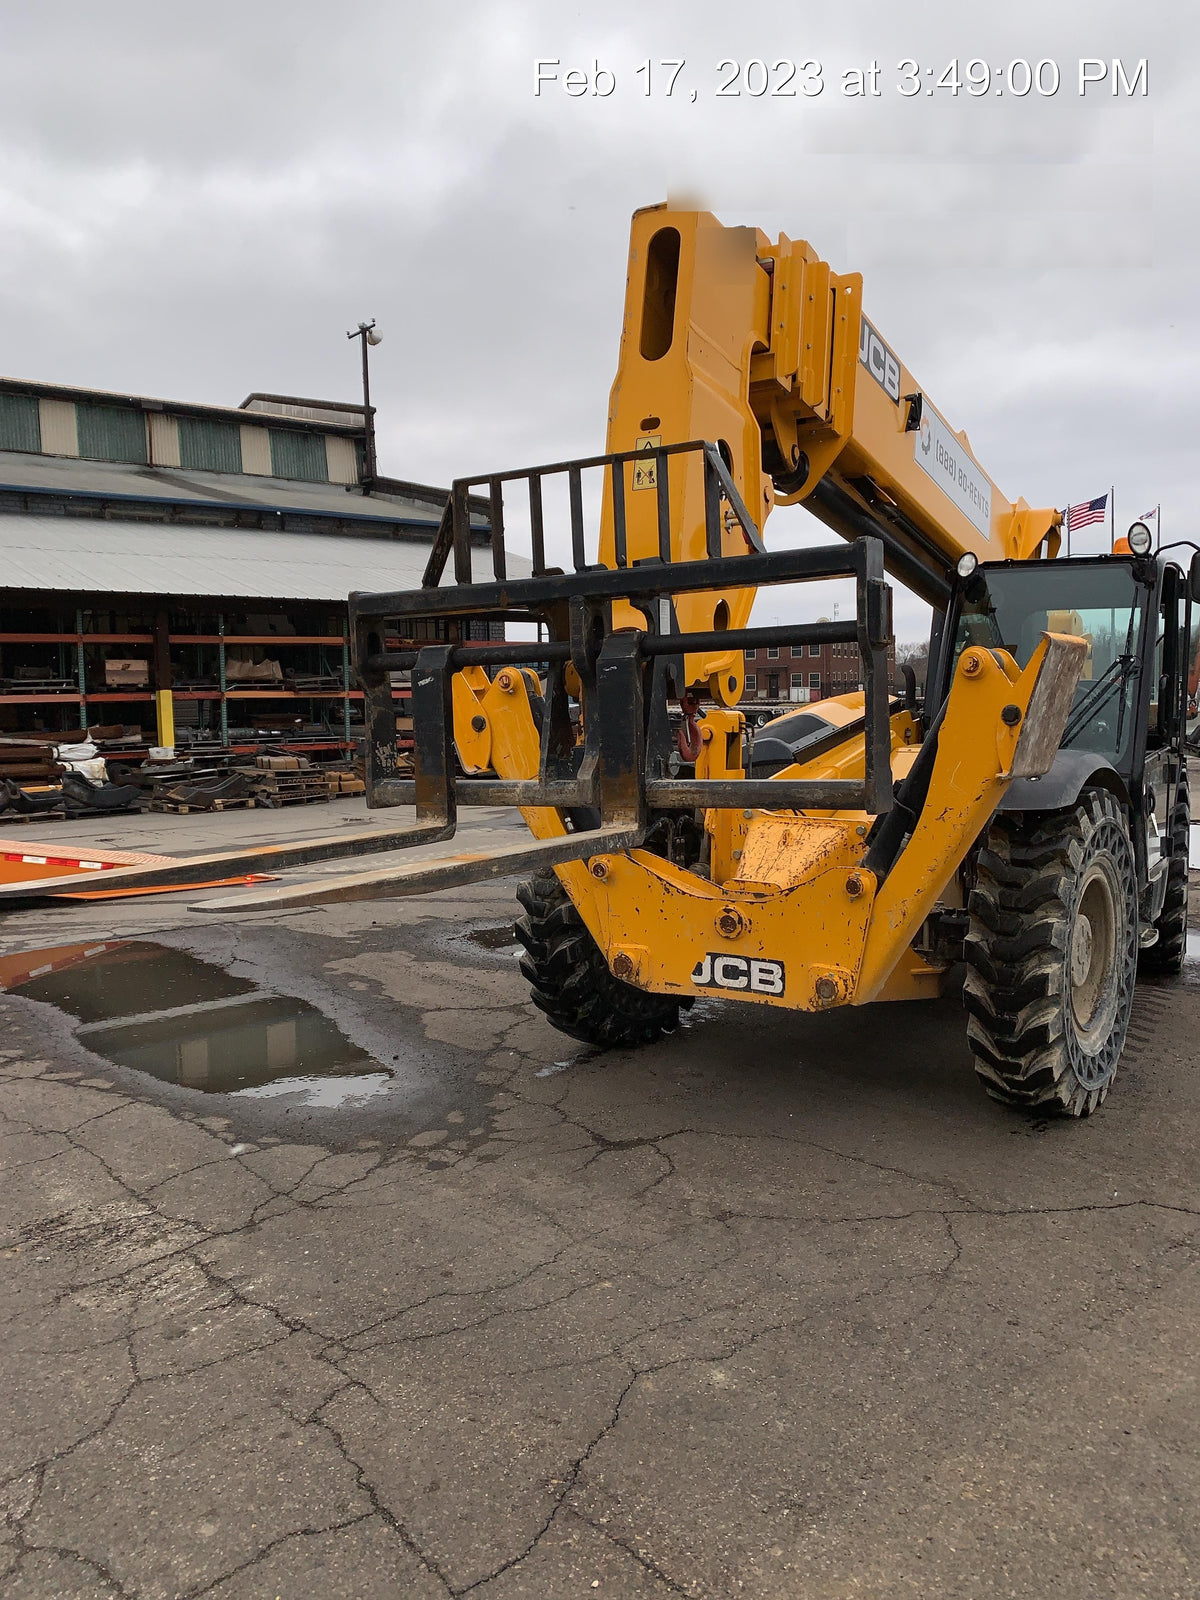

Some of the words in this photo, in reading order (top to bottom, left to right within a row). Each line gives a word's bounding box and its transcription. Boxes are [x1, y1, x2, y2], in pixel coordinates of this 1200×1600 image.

[859, 324, 900, 400] JCB
[936, 440, 956, 481] (888)
[690, 955, 783, 994] JCB
